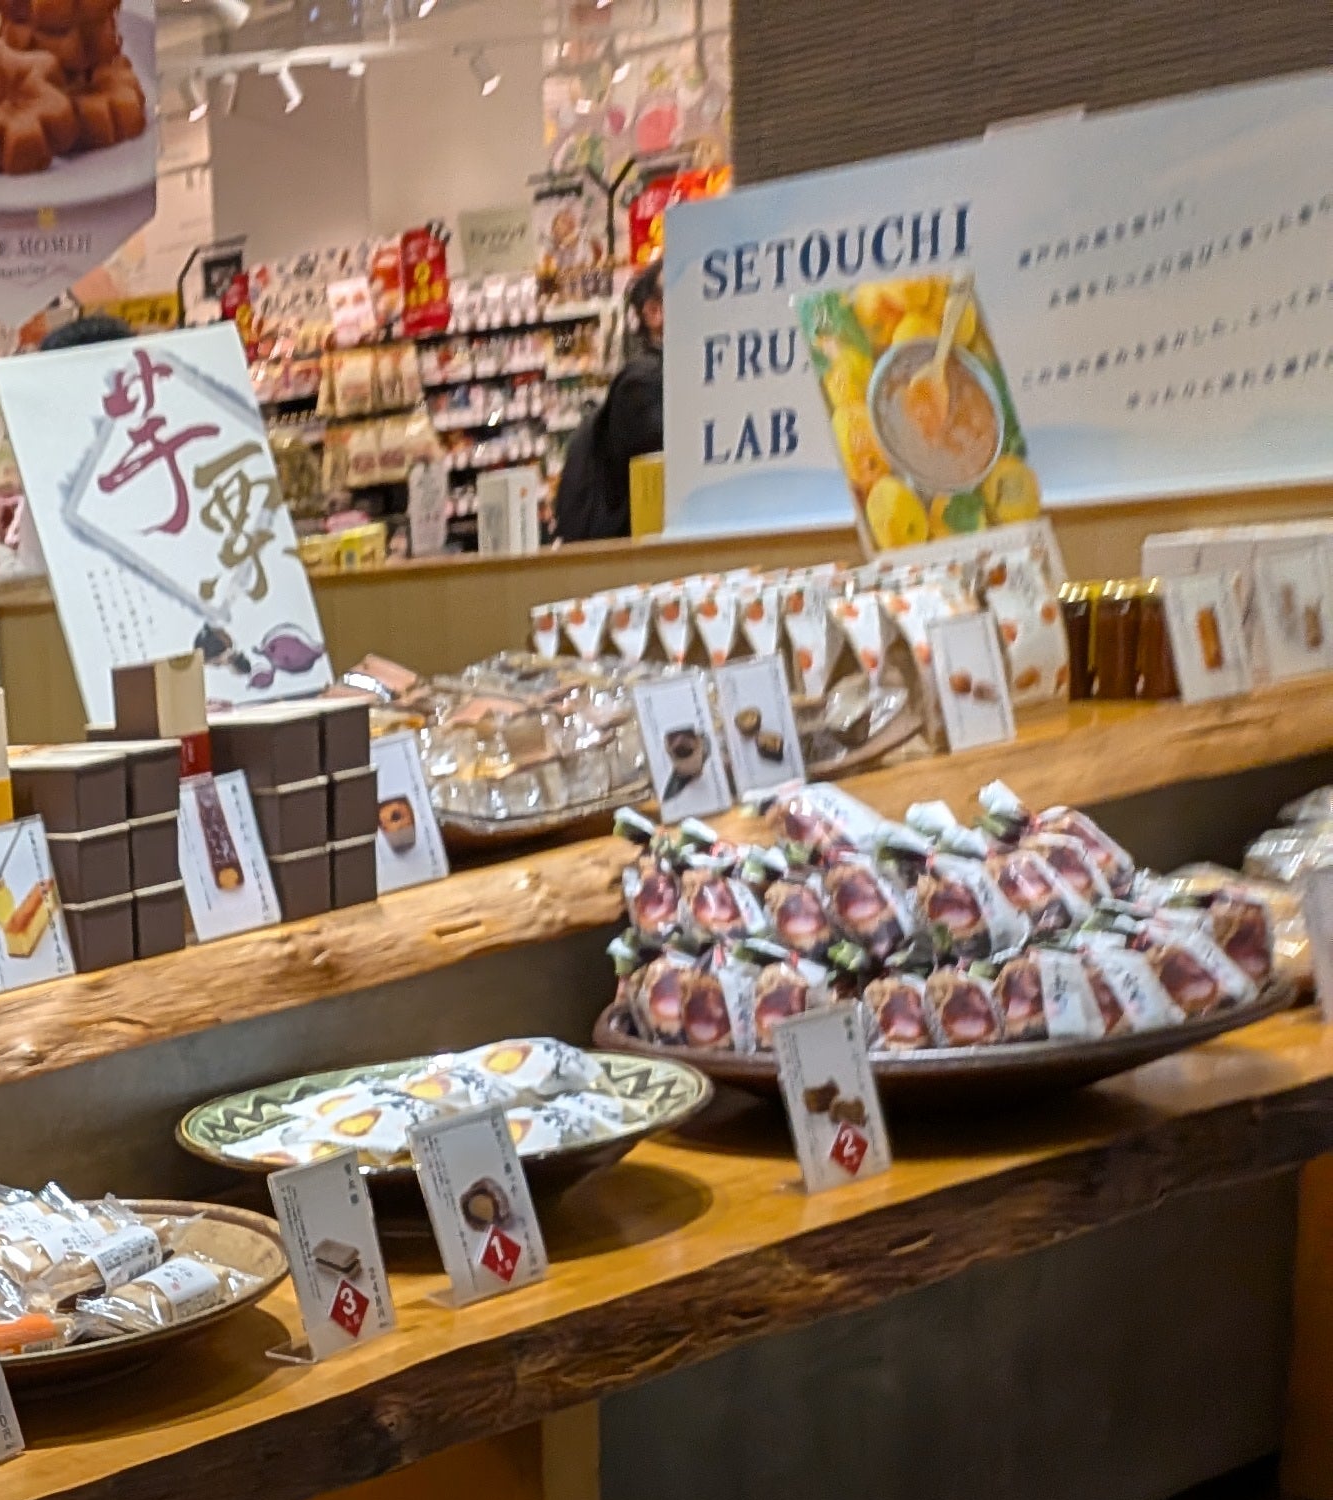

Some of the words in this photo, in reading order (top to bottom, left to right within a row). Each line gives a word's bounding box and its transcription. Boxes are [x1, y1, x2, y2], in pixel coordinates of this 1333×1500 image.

[702, 201, 973, 300] SETOUCHI
[703, 325, 811, 385] FRU
[702, 407, 800, 465] LAB
[340, 1287, 358, 1316] 3
